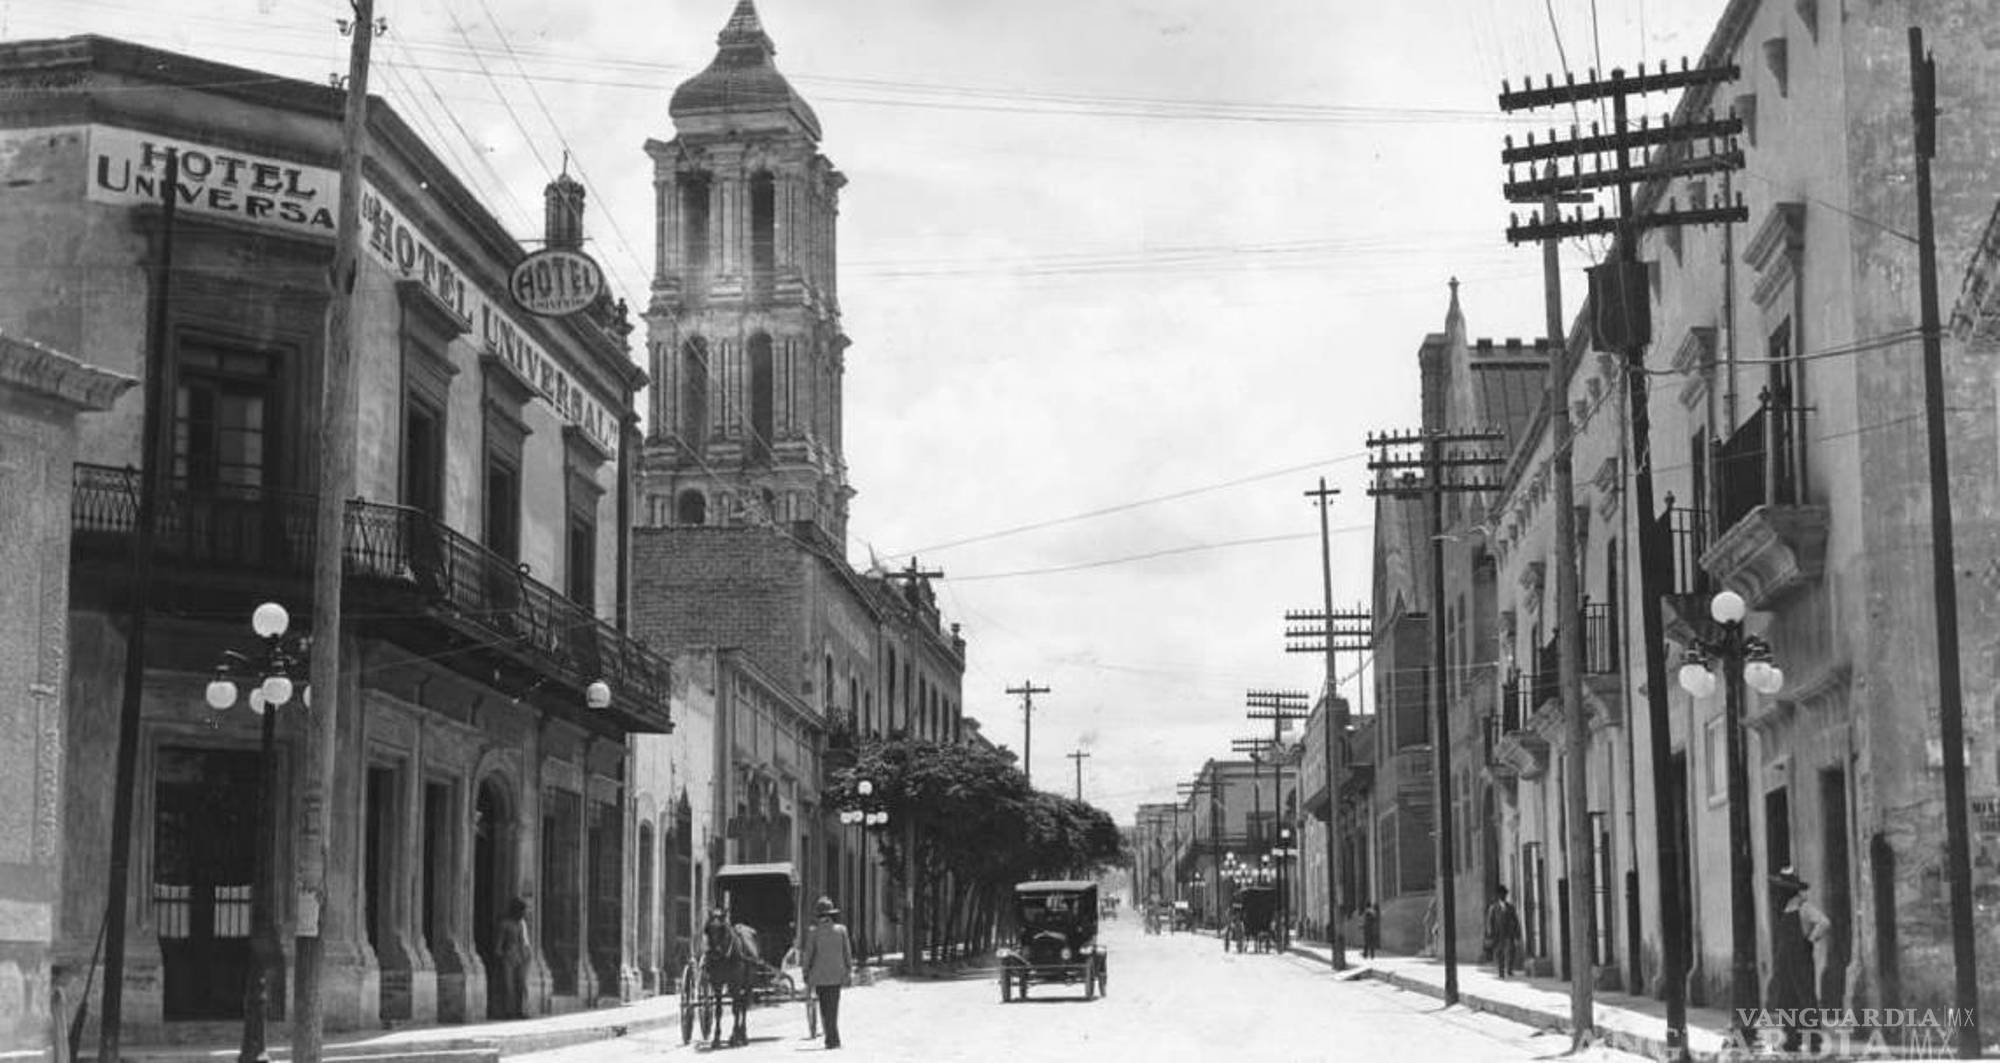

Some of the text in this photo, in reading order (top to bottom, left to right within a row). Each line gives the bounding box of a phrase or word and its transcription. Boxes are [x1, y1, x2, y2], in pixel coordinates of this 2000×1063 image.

[97, 154, 335, 229] UNIVERSA
[141, 142, 317, 200] HOTEL
[518, 256, 596, 301] HOTEL
